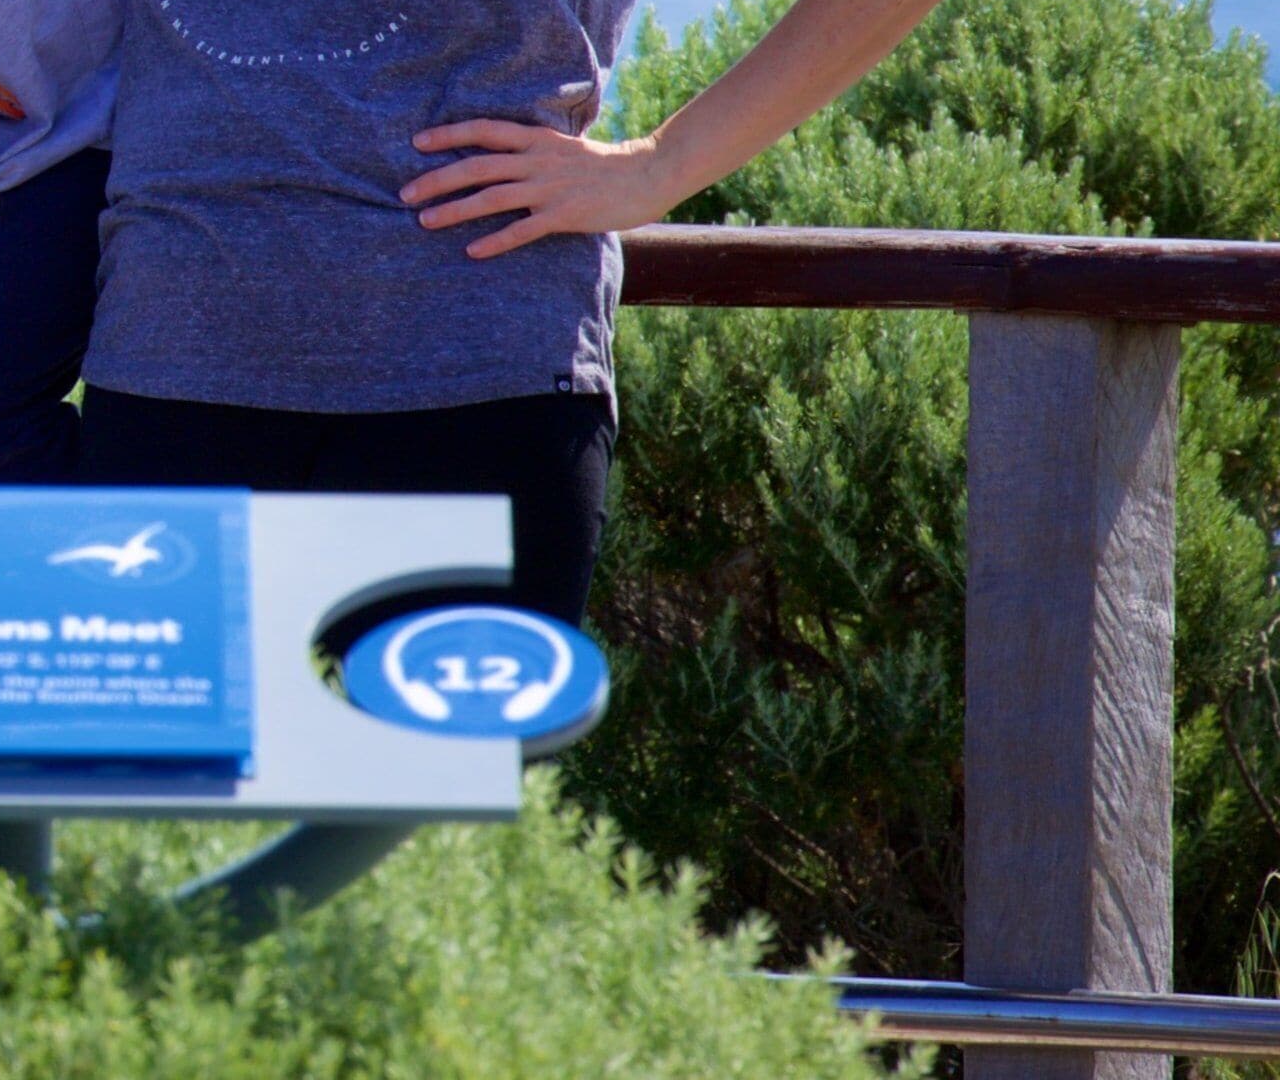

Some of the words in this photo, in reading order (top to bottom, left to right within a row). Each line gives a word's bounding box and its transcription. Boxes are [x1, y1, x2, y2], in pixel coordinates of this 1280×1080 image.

[196, 40, 285, 66] ELEMENT
[60, 614, 183, 644] Meet
[434, 656, 522, 692] 12
